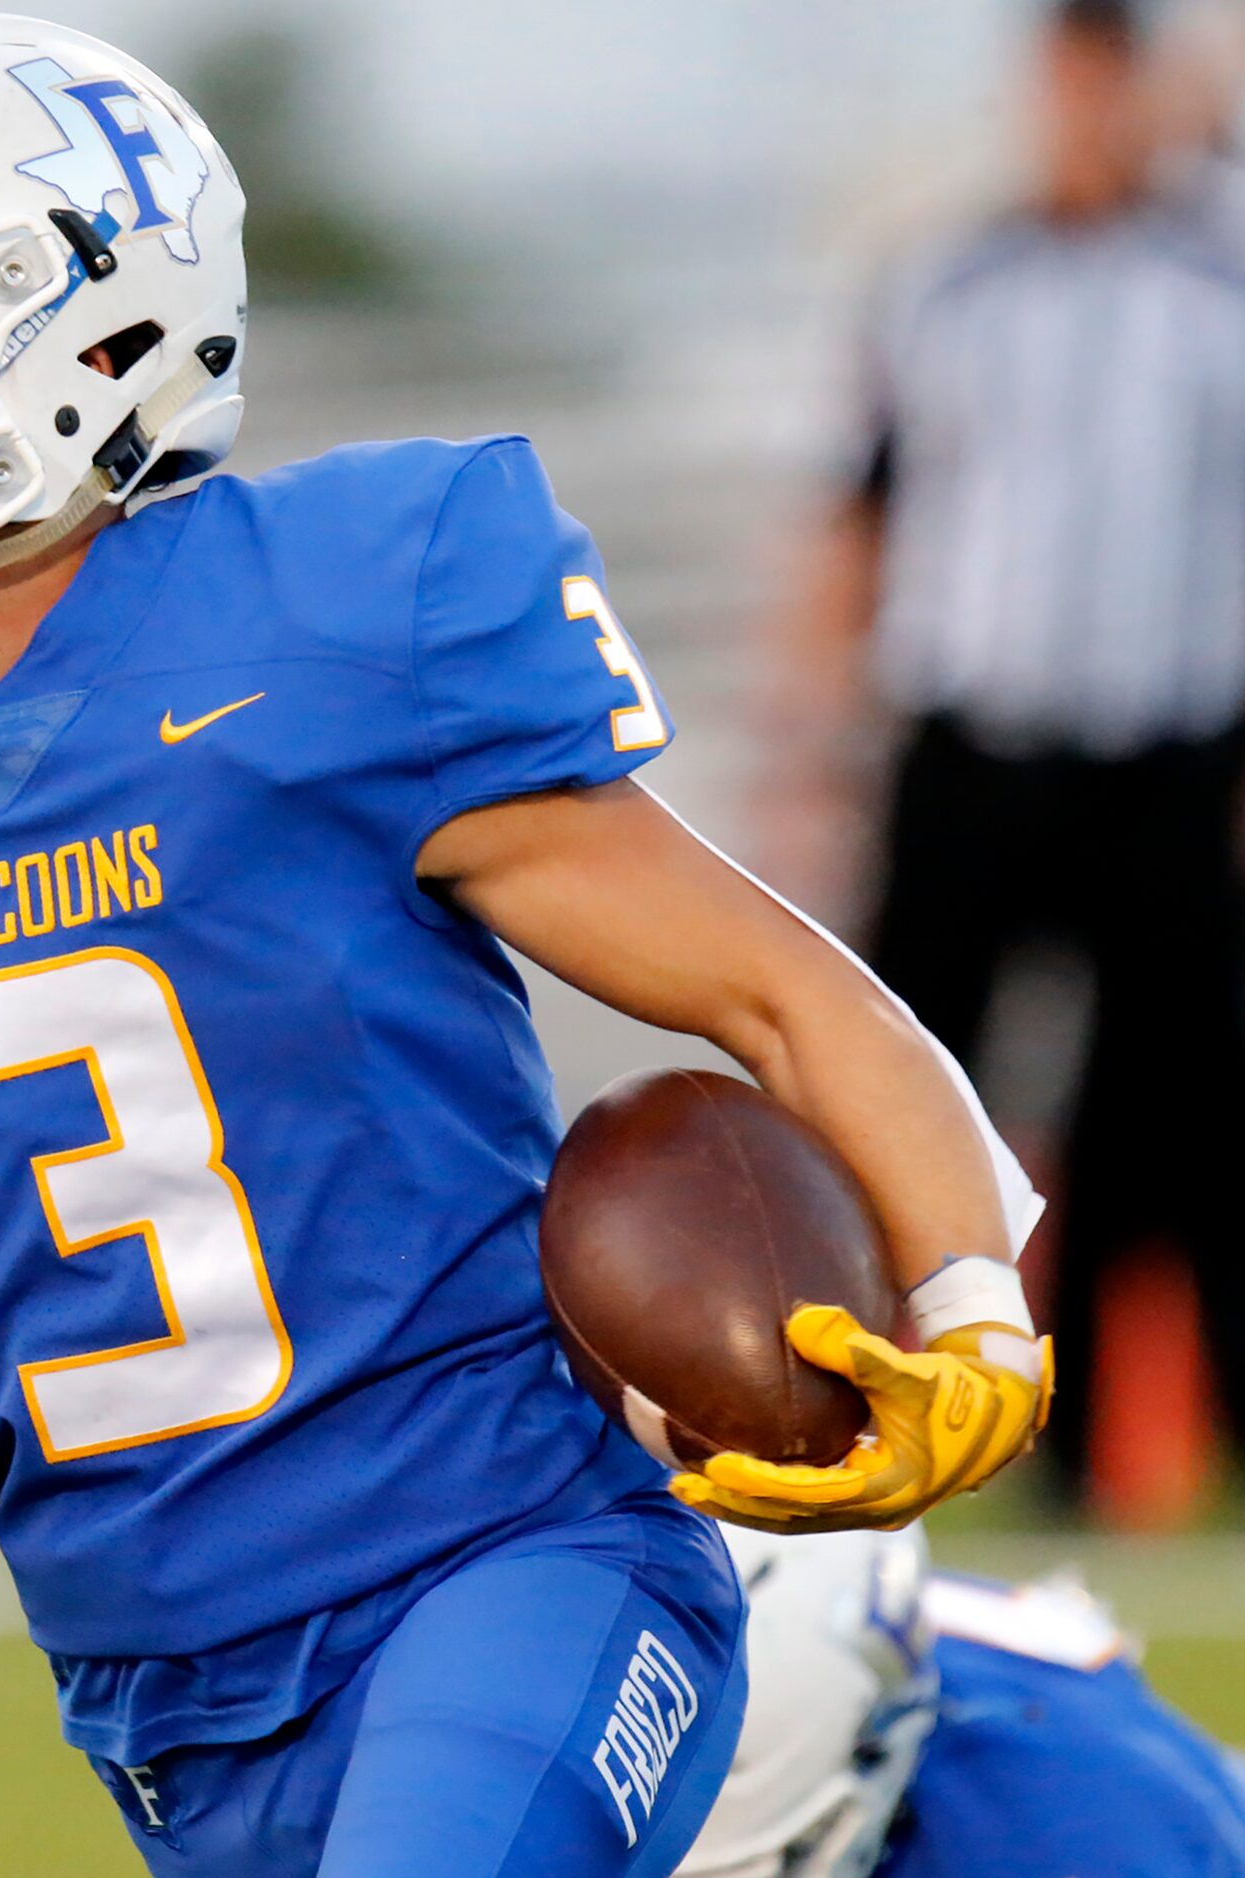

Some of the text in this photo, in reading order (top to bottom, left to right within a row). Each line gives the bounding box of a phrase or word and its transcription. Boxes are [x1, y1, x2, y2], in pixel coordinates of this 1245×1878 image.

[55, 76, 178, 236] F
[562, 575, 667, 752] 3
[124, 1765, 164, 1826] F
[593, 1629, 698, 1850] FRISCO
